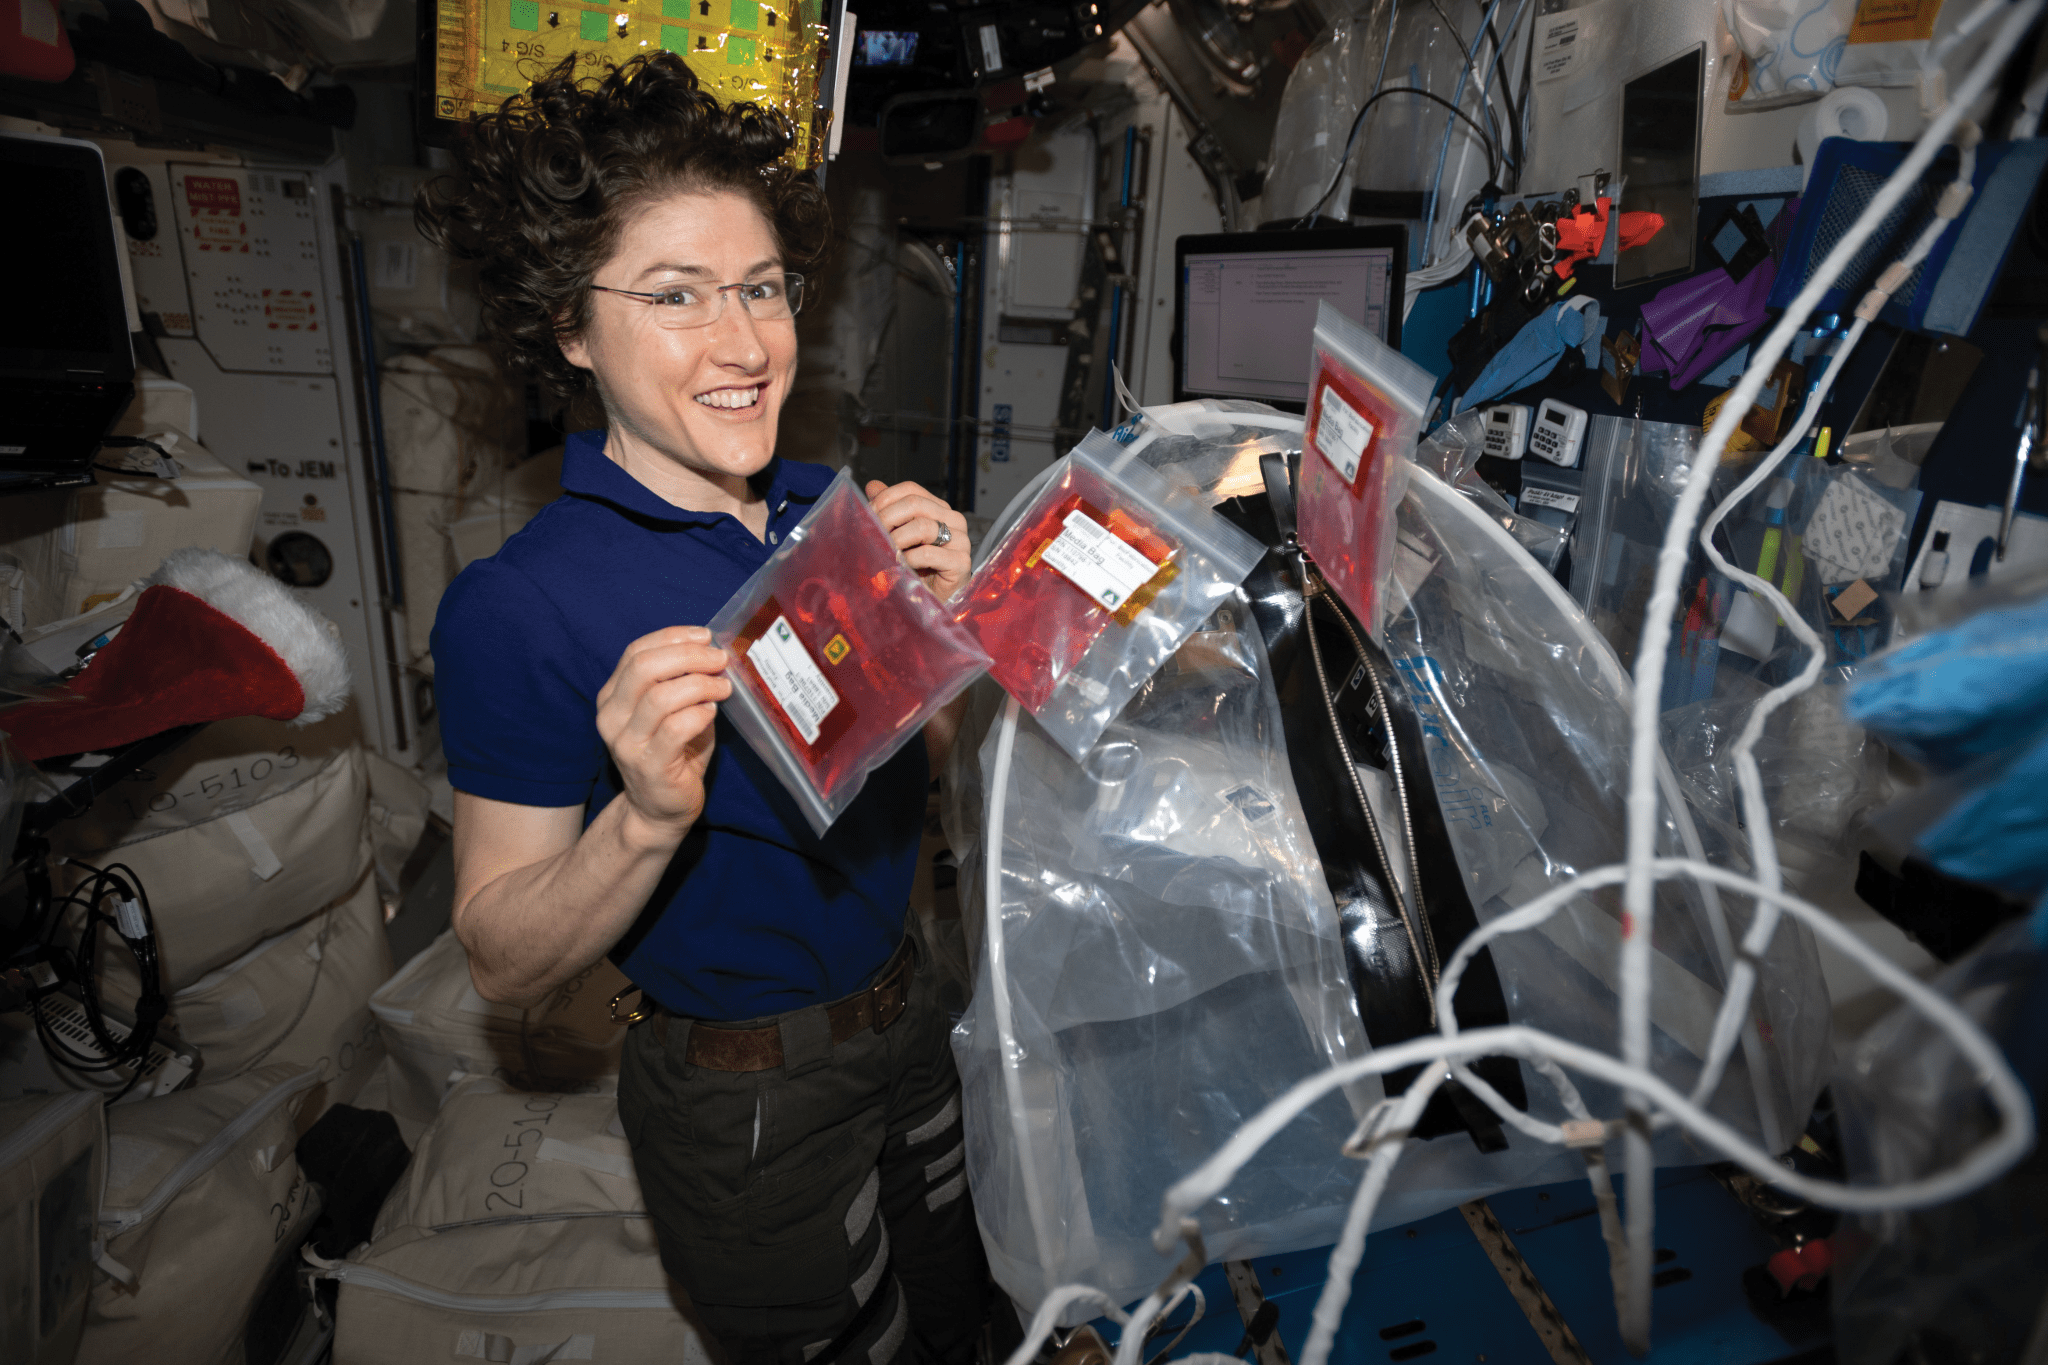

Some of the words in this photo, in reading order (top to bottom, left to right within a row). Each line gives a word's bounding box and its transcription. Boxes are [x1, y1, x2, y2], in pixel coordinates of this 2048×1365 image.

[502, 39, 510, 52] 4
[516, 42, 545, 58] S/G
[267, 458, 289, 478] To
[296, 460, 335, 479] JEM
[1062, 528, 1088, 550] Media
[1084, 546, 1107, 566] Bag
[783, 669, 801, 693] Bag
[797, 691, 819, 723] Media
[1480, 804, 1493, 828] FLEX
